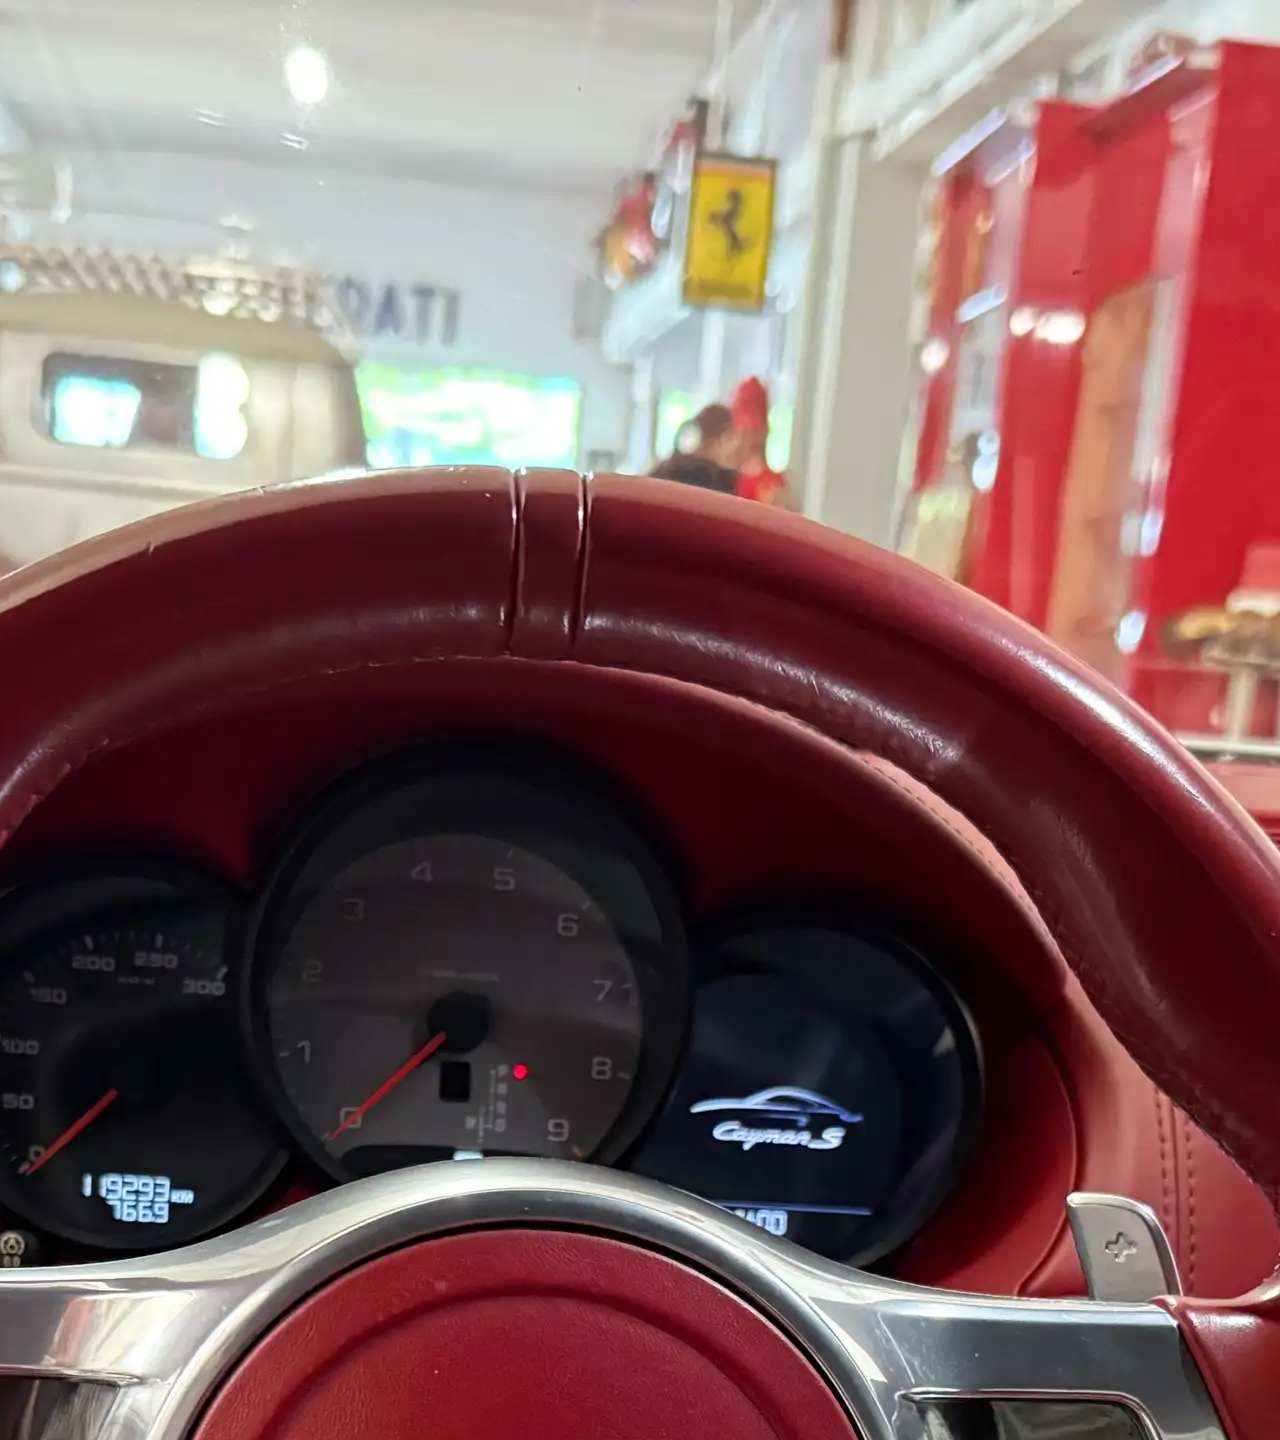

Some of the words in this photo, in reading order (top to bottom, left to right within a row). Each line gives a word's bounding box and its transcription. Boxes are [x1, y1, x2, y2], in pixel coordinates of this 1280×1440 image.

[411, 861, 434, 883] 4
[493, 868, 516, 891] 5
[344, 899, 365, 922] 3
[557, 913, 579, 937] 6
[71, 954, 116, 972] 200
[134, 953, 178, 969] 250
[301, 960, 324, 984] 2
[181, 978, 226, 996] 300
[591, 978, 613, 1002] 7
[1, 1038, 39, 1055] 100
[296, 1040, 312, 1063] 1
[591, 1056, 613, 1080] 8
[1, 1093, 35, 1110] 50
[547, 1118, 570, 1142] 9
[712, 1120, 812, 1151] Cayman
[807, 1126, 847, 1150] S
[81, 1172, 171, 1201] 119293
